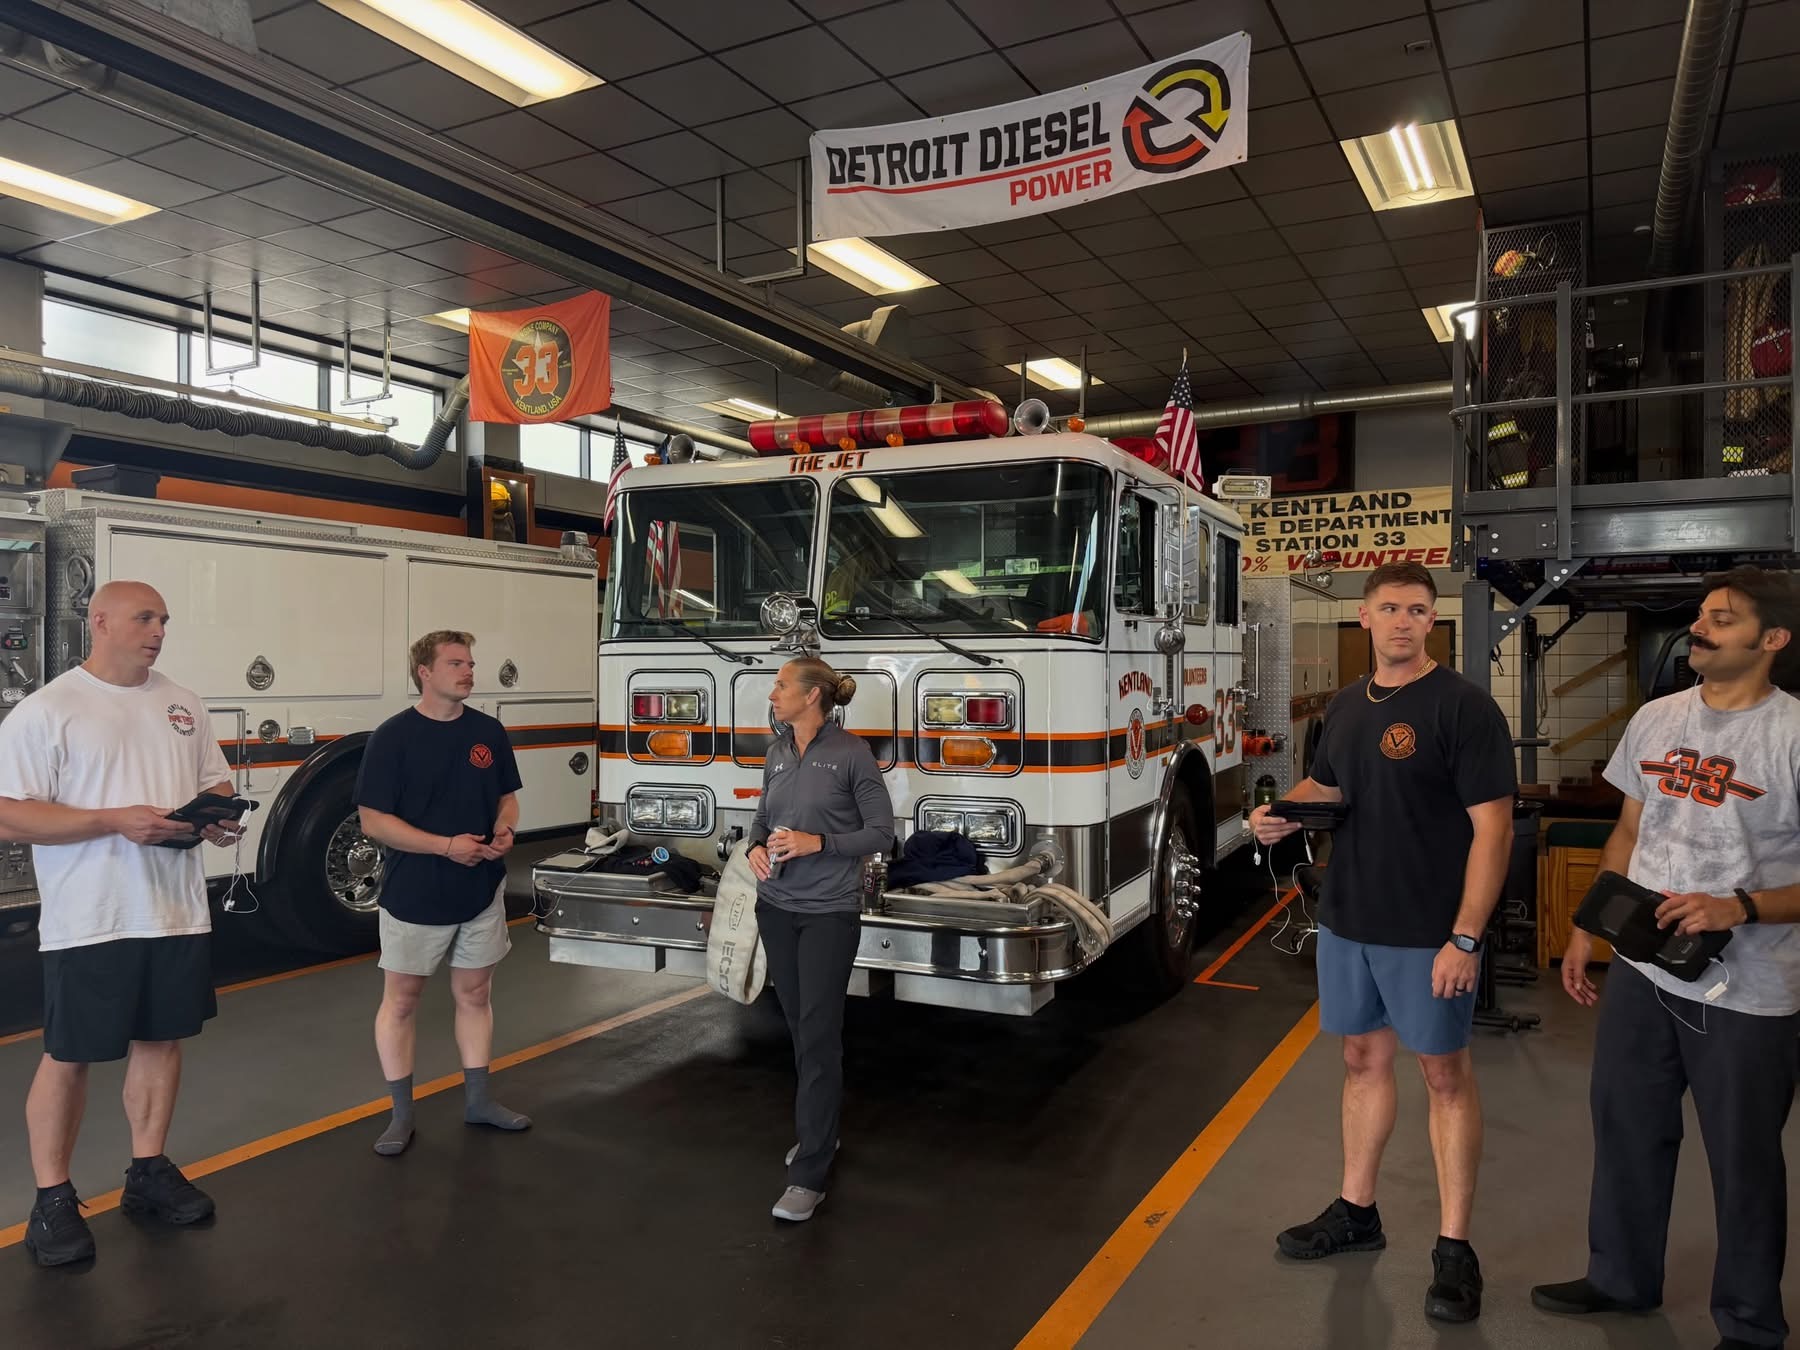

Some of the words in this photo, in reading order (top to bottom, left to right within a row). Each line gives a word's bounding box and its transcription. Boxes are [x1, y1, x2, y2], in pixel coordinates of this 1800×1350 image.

[827, 132, 969, 185] DETROIT
[979, 101, 1111, 173] DIESEL
[1009, 159, 1113, 206] POWER
[513, 340, 559, 397] 33
[548, 395, 562, 410] USA
[789, 454, 826, 474] THE
[827, 451, 870, 471] JET
[1250, 491, 1412, 519] KENTLAND
[1280, 509, 1452, 534] DEPARTMENT
[1256, 533, 1359, 553] STATION
[1373, 531, 1406, 547] 33
[1288, 547, 1452, 571] VUNTEE
[1118, 671, 1153, 701] KENTLAND
[1215, 688, 1236, 758] 33
[812, 761, 838, 770] ELITE
[1658, 747, 1737, 808] 33
